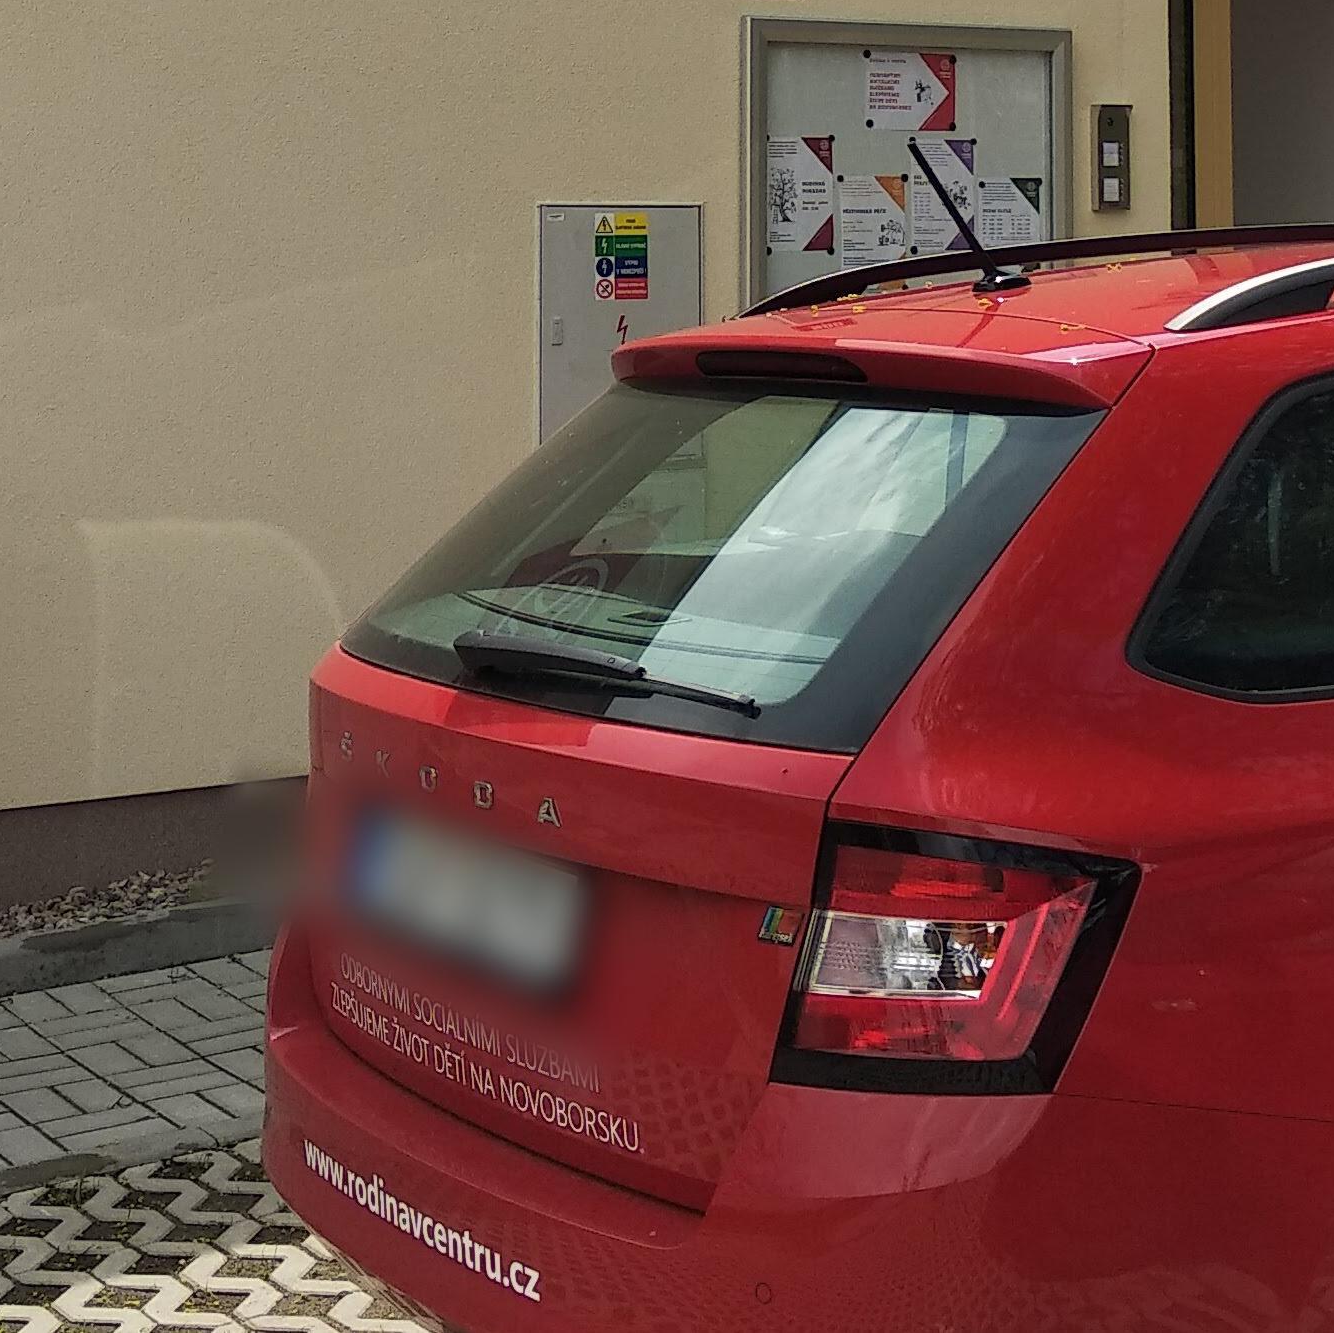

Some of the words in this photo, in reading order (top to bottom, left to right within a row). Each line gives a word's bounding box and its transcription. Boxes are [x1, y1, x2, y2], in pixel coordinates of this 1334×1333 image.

[330, 981, 391, 1046] ZLEPŠUJEME
[391, 1016, 431, 1067] ŽIVOT
[433, 1041, 467, 1086] DĚTÍ
[470, 1061, 497, 1100] NA
[499, 1074, 646, 1155] NOVOBORSKU.
[303, 1138, 541, 1302] www.rodinavcentru.cz
